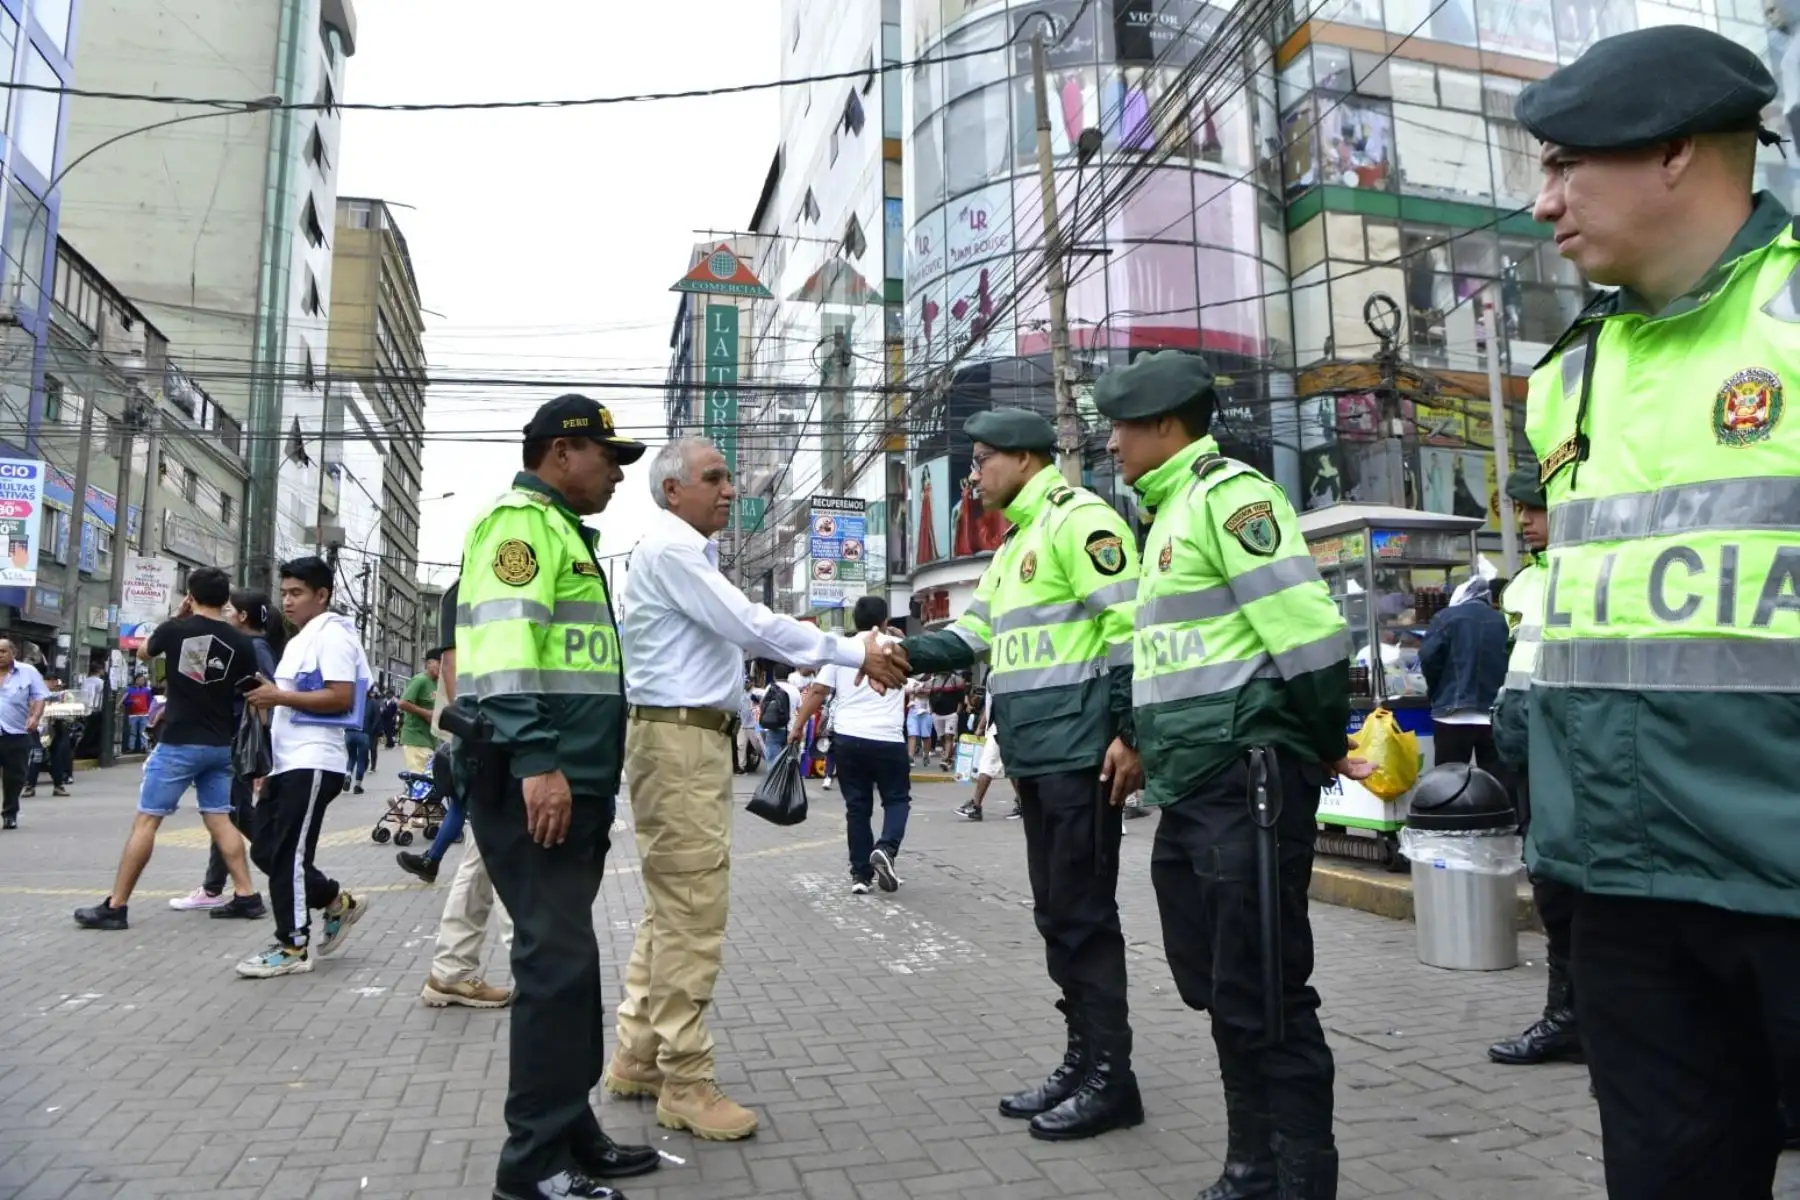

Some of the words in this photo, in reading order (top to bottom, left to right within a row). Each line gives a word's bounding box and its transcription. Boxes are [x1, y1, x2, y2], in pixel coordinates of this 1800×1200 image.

[1129, 11, 1178, 25] VICTOR
[691, 281, 766, 295] COMERCIAL
[711, 366, 731, 462] TORR
[562, 418, 588, 429] PERU
[813, 498, 864, 510] RECUPEREMOS
